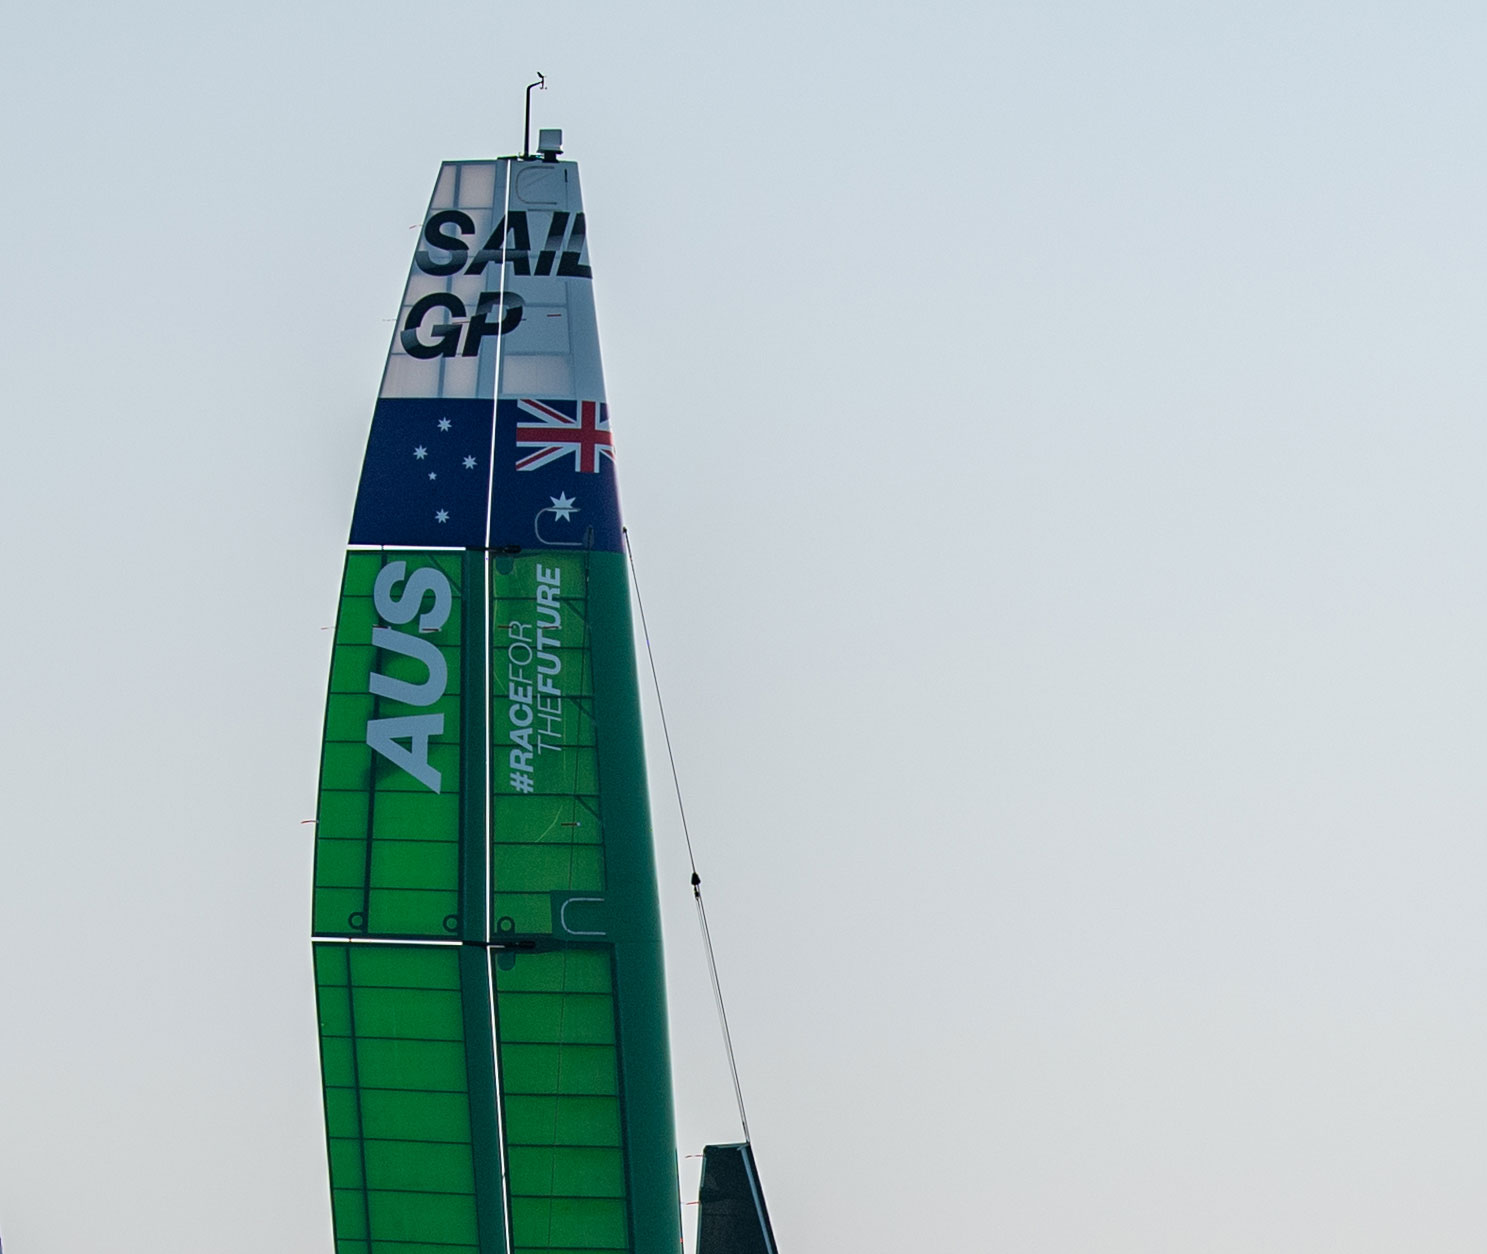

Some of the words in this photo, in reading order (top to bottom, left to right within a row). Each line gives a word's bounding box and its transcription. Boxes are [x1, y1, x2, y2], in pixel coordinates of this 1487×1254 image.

[400, 291, 526, 360] GP
[415, 210, 593, 279] SAIL
[366, 560, 453, 795] AUS
[508, 620, 534, 794] #RACEFOR
[536, 563, 561, 755] THEFUTURE
